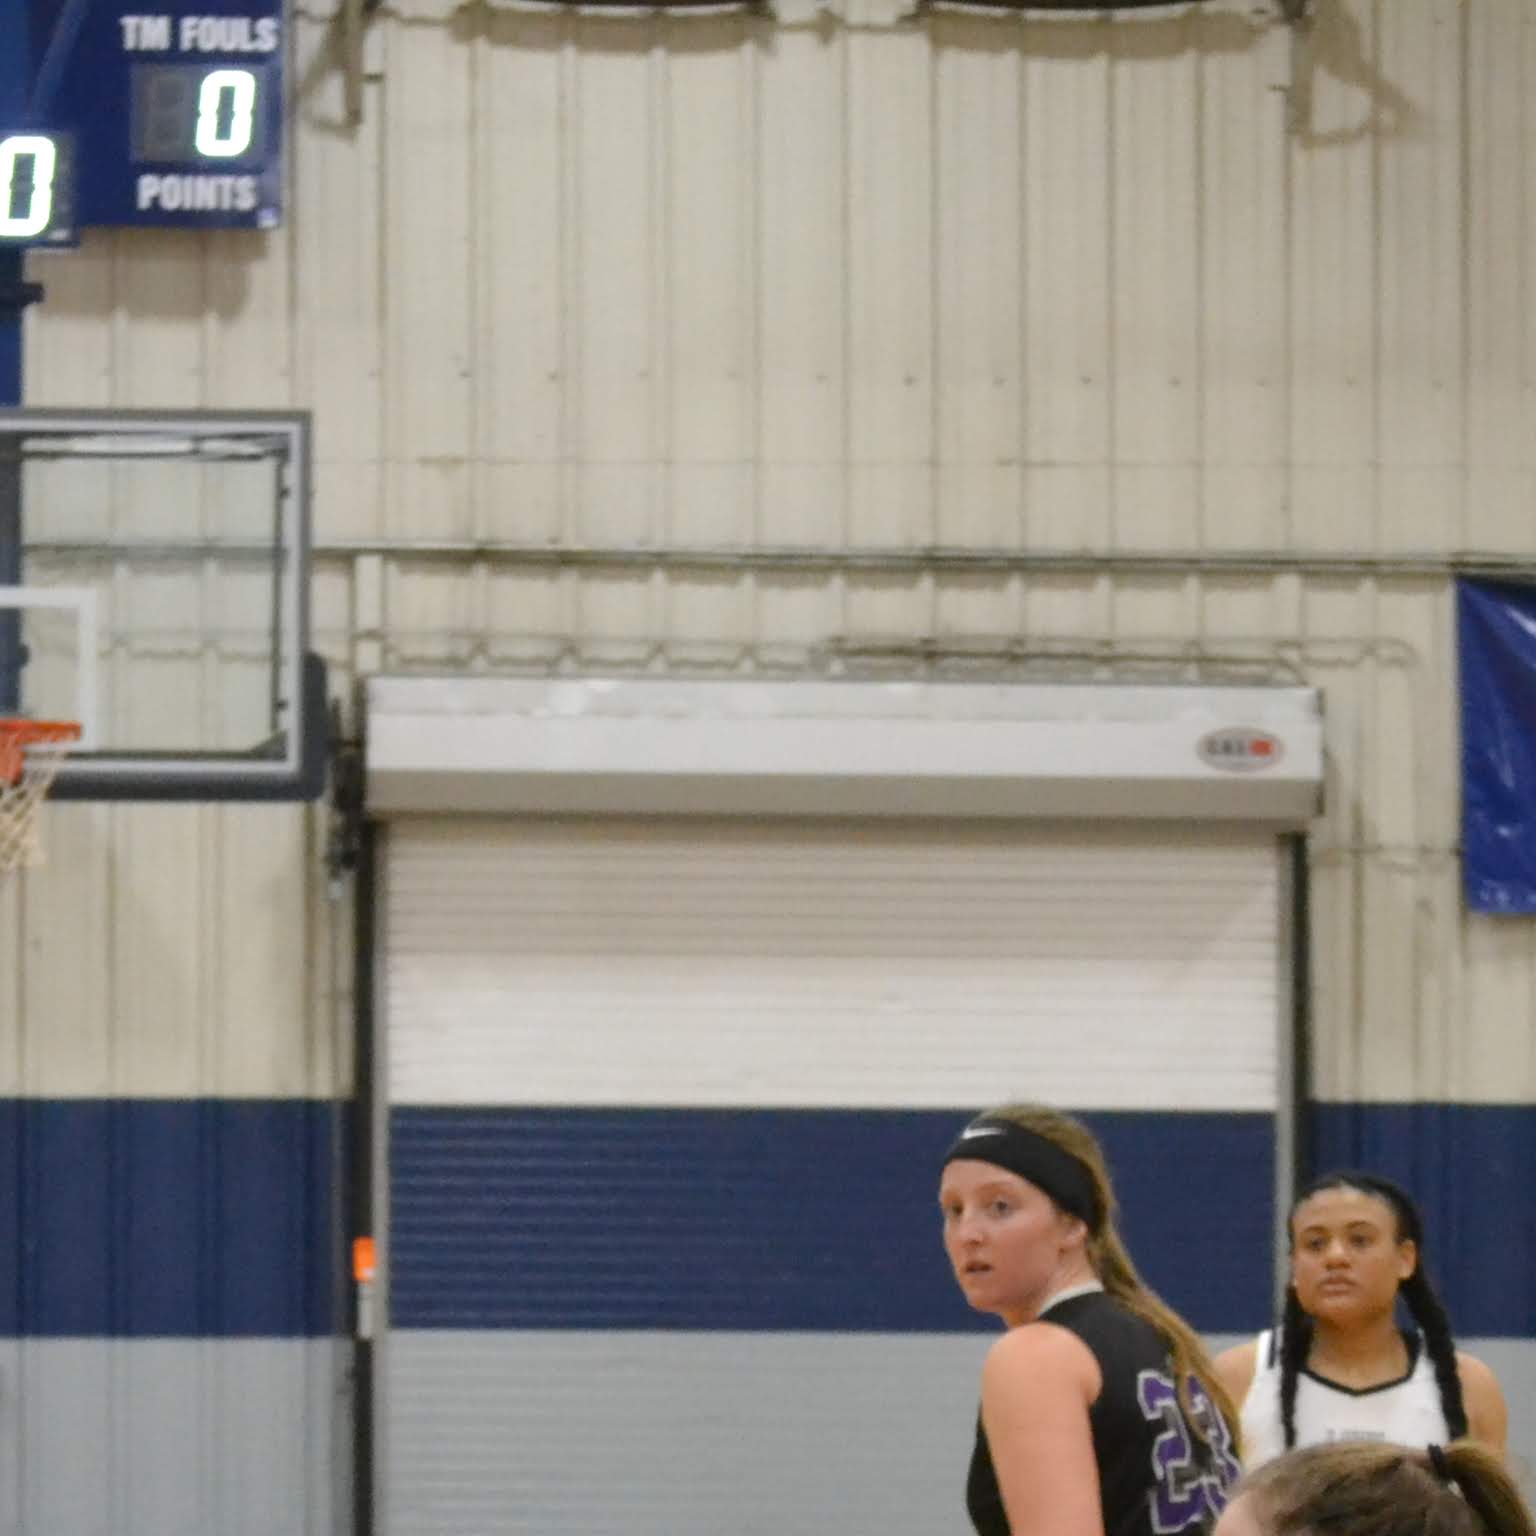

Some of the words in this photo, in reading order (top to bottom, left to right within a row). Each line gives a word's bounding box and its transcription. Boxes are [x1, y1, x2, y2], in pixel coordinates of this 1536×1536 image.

[120, 14, 172, 51] TM
[178, 16, 280, 53] FOULS
[195, 69, 256, 157] 0
[136, 173, 257, 211] POINTS
